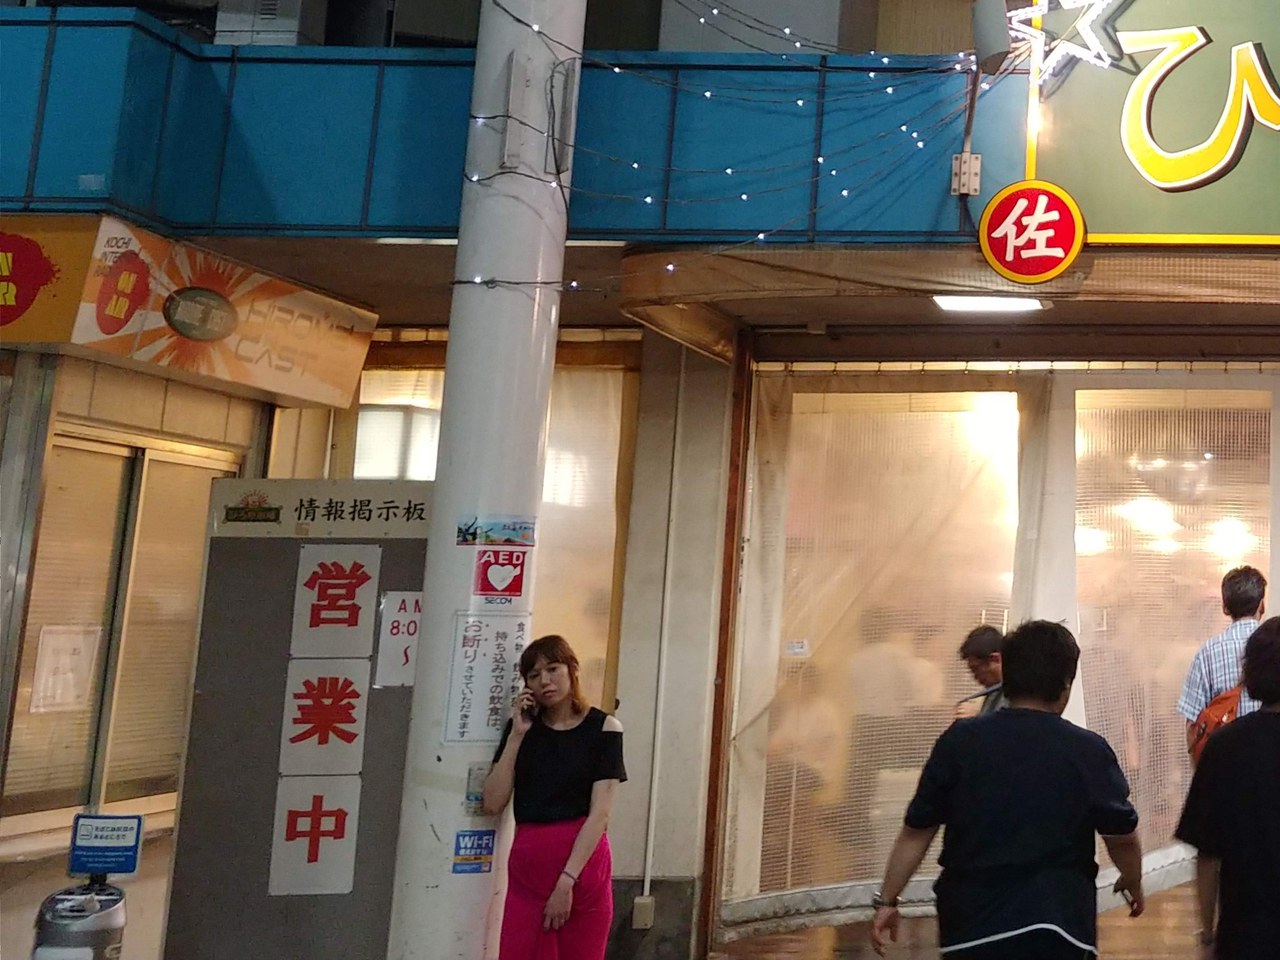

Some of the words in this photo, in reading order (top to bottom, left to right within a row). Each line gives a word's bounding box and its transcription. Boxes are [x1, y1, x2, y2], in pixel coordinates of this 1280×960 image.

[991, 196, 1066, 262] 佐
[294, 498, 427, 522] 情報掲示板
[479, 551, 524, 564] AED
[285, 560, 373, 864] 営業中
